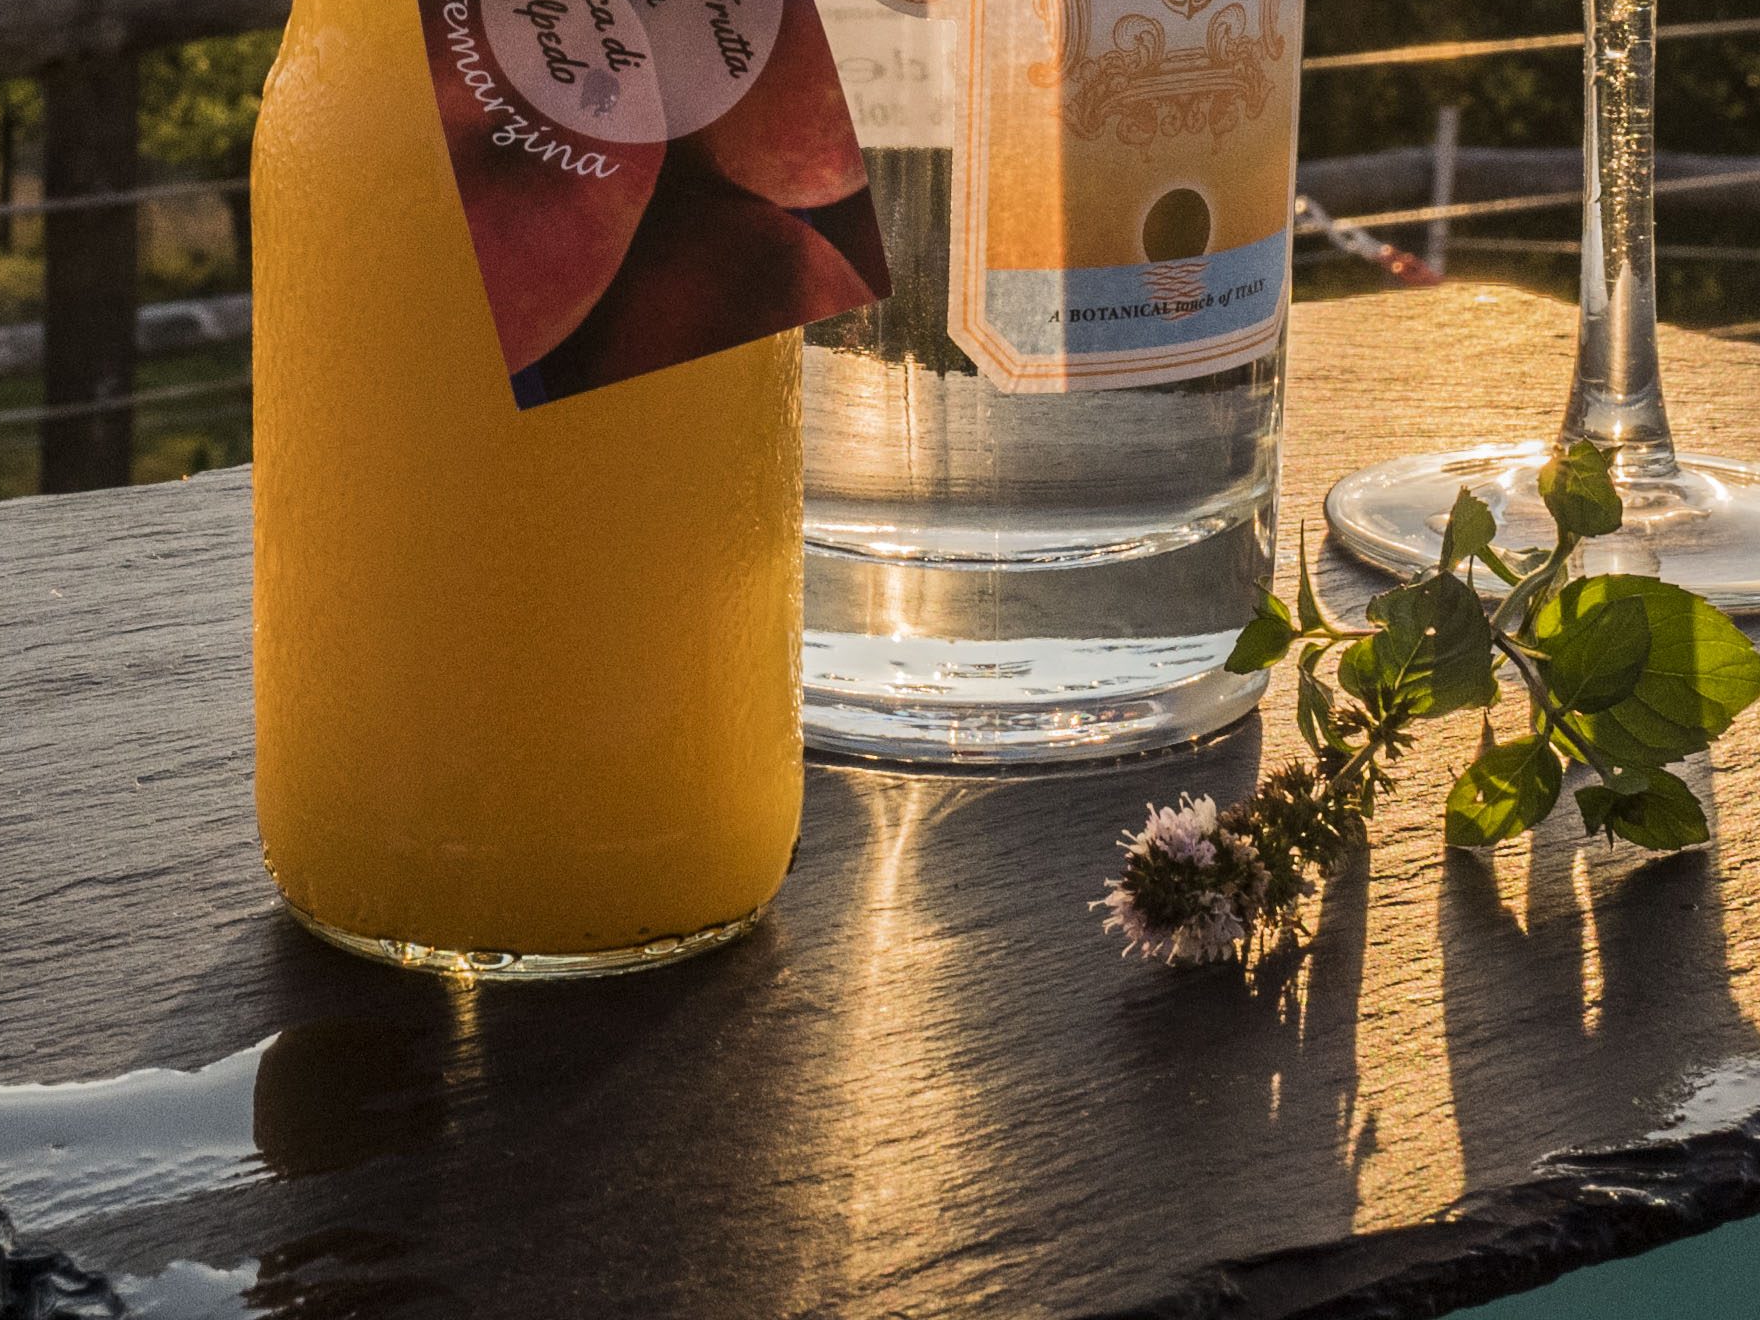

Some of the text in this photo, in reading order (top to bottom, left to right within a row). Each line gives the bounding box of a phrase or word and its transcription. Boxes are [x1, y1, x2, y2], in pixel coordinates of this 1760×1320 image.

[601, 36, 647, 73] di
[1048, 278, 1268, 324] A BOTANICAL touch of ITALY
